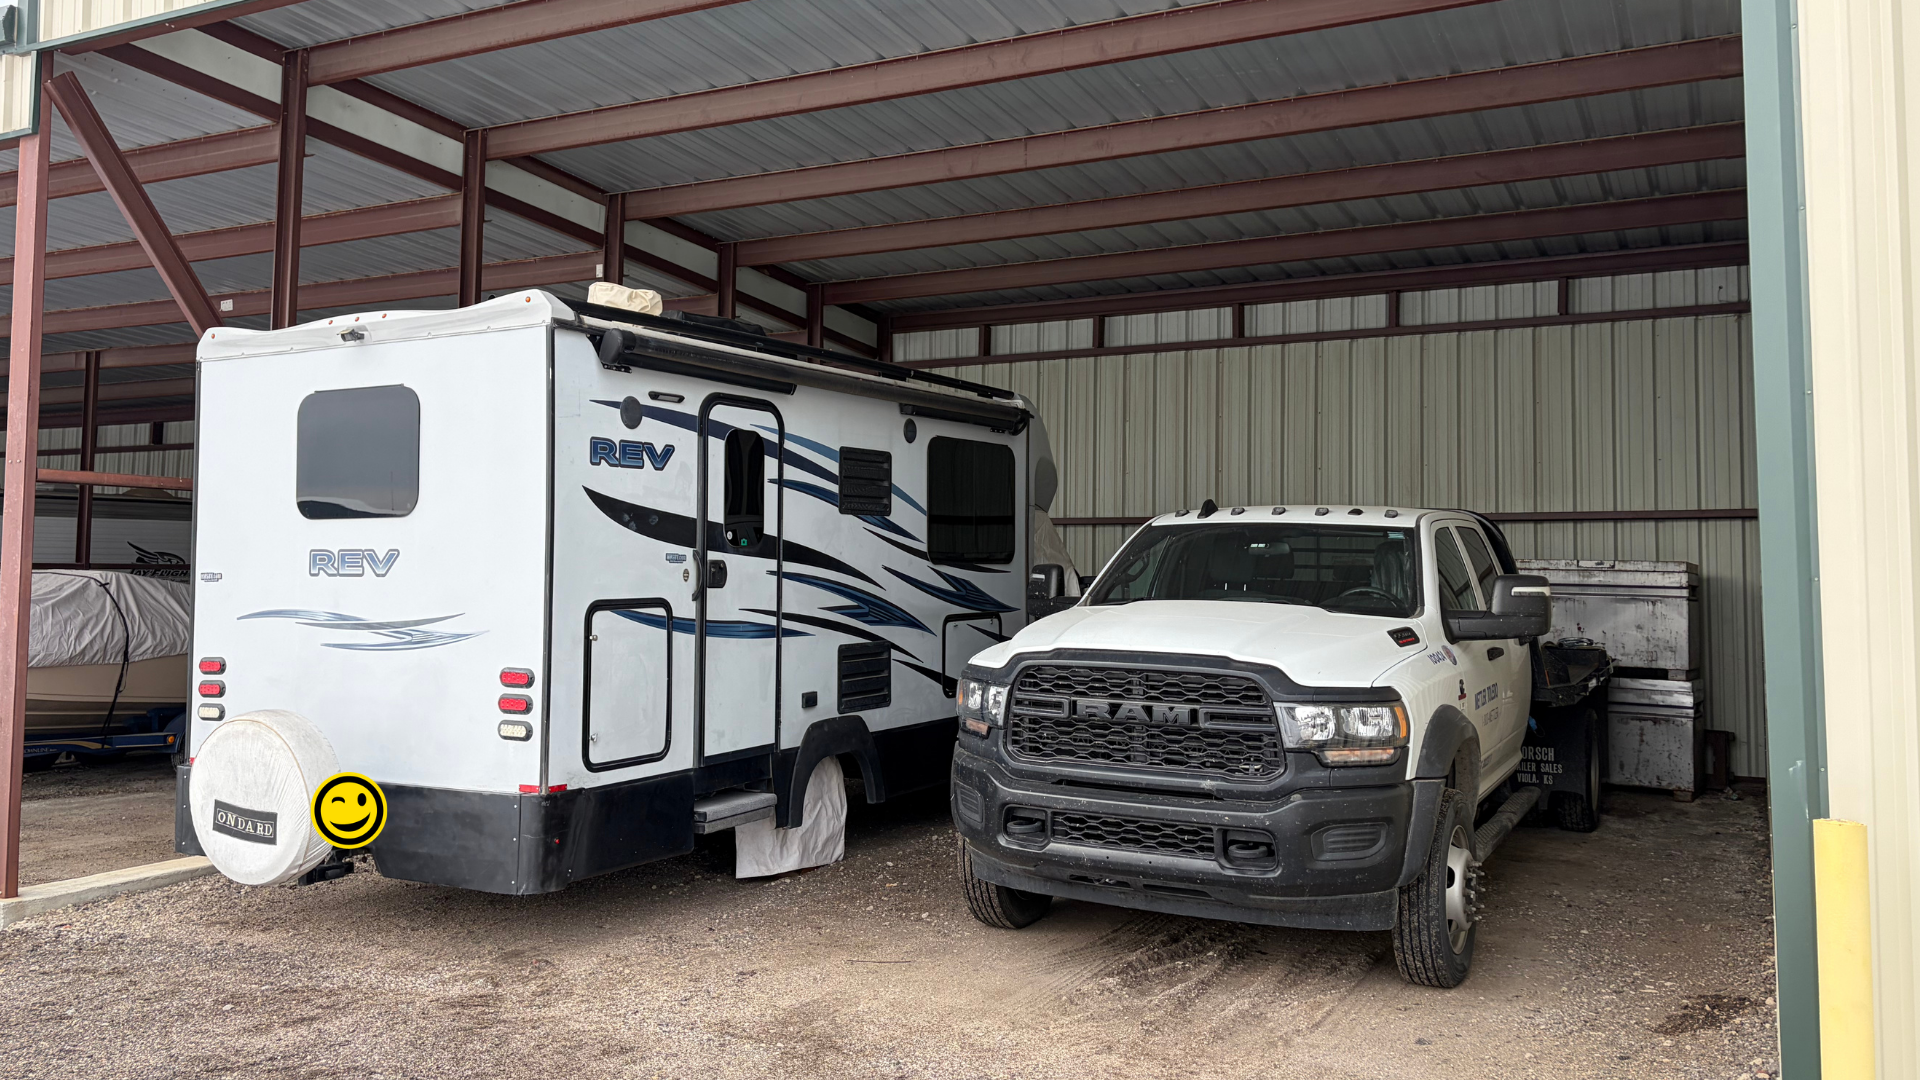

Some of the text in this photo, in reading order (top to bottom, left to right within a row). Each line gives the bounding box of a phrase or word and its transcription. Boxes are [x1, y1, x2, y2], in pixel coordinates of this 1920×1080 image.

[590, 436, 675, 471] REV
[309, 549, 400, 577] REV
[1076, 699, 1191, 724] RAM
[1521, 746, 1555, 761] ORSCH
[1540, 762, 1563, 774] SALES
[1543, 774, 1554, 785] KS
[217, 811, 273, 835] ONDARD
